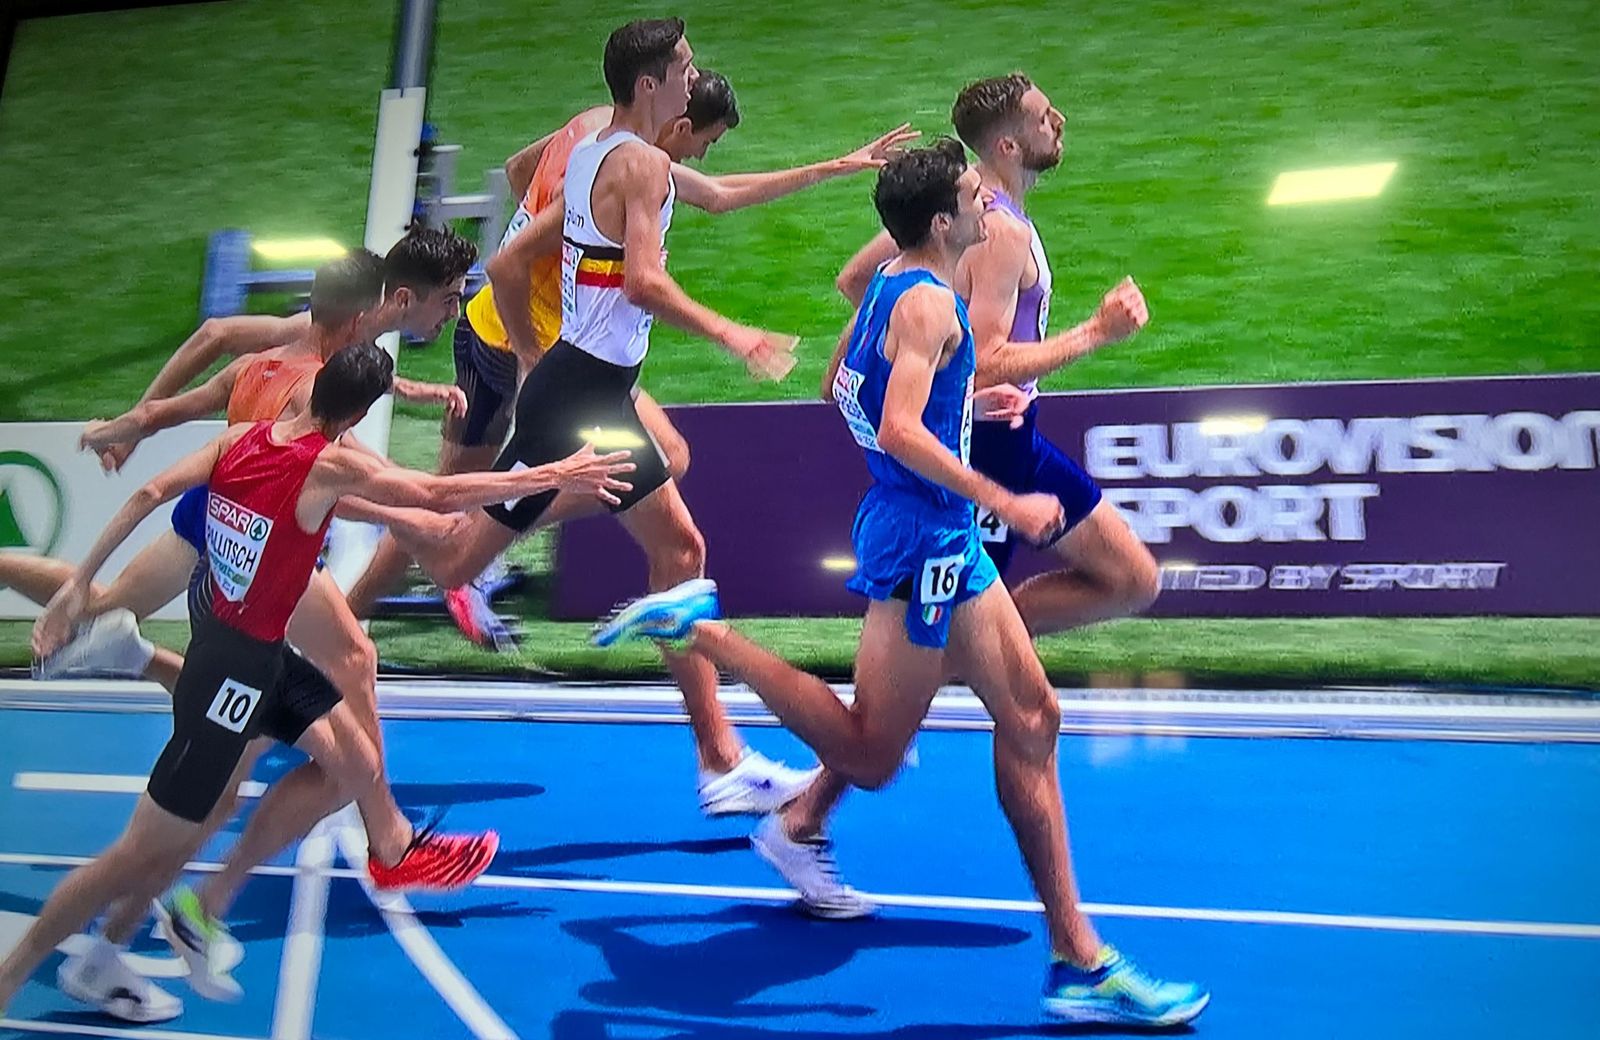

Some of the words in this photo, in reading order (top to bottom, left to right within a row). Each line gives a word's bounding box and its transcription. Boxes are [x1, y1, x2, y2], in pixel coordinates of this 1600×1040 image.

[1084, 409, 1600, 480] EUROVISION
[209, 498, 251, 533] SPAR
[980, 511, 1001, 536] 4
[930, 562, 956, 597] 16
[217, 686, 252, 725] 10
